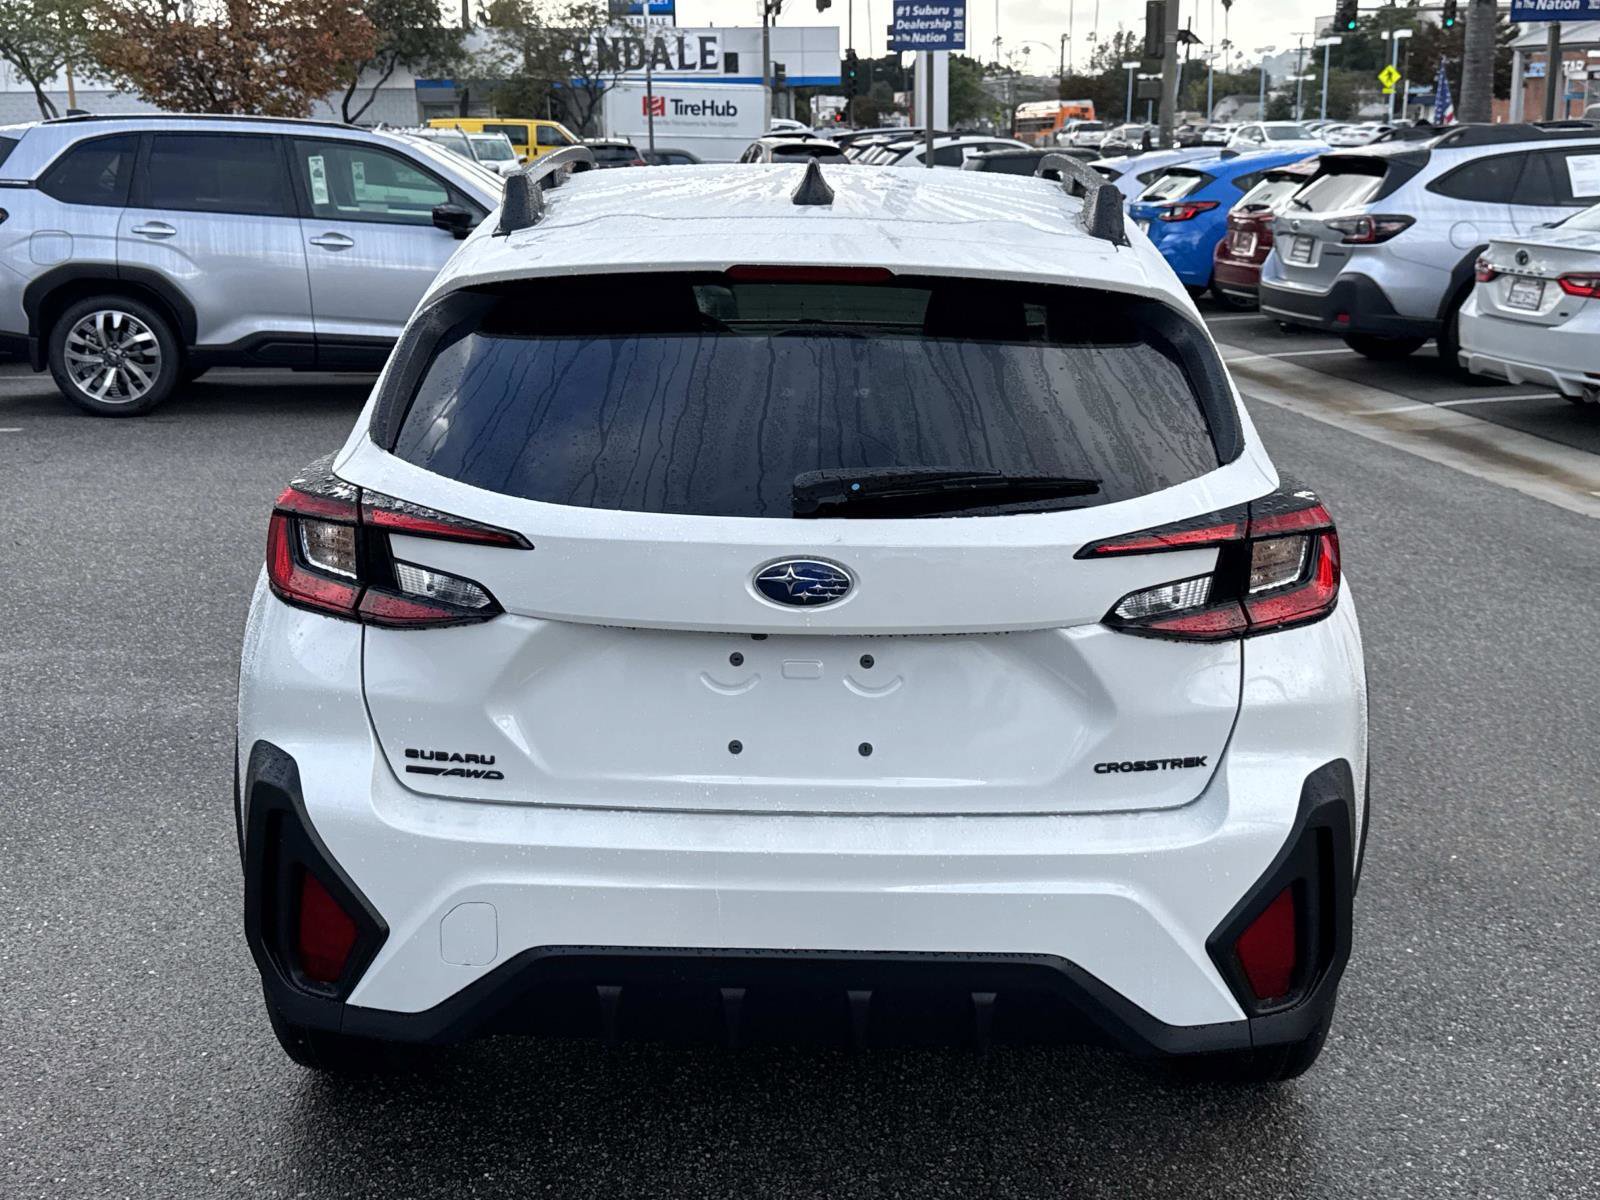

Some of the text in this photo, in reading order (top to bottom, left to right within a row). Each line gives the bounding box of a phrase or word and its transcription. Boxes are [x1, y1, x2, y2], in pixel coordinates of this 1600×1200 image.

[896, 5, 910, 17] #1
[912, 4, 950, 16] Subaru
[1536, 0, 1579, 10] Nation
[896, 19, 952, 31] Dealership
[912, 32, 947, 42] Nation
[670, 98, 738, 117] TireHub
[404, 748, 496, 765] SUBARU
[1093, 755, 1208, 774] CROSSTREK
[441, 767, 505, 781] AWD
